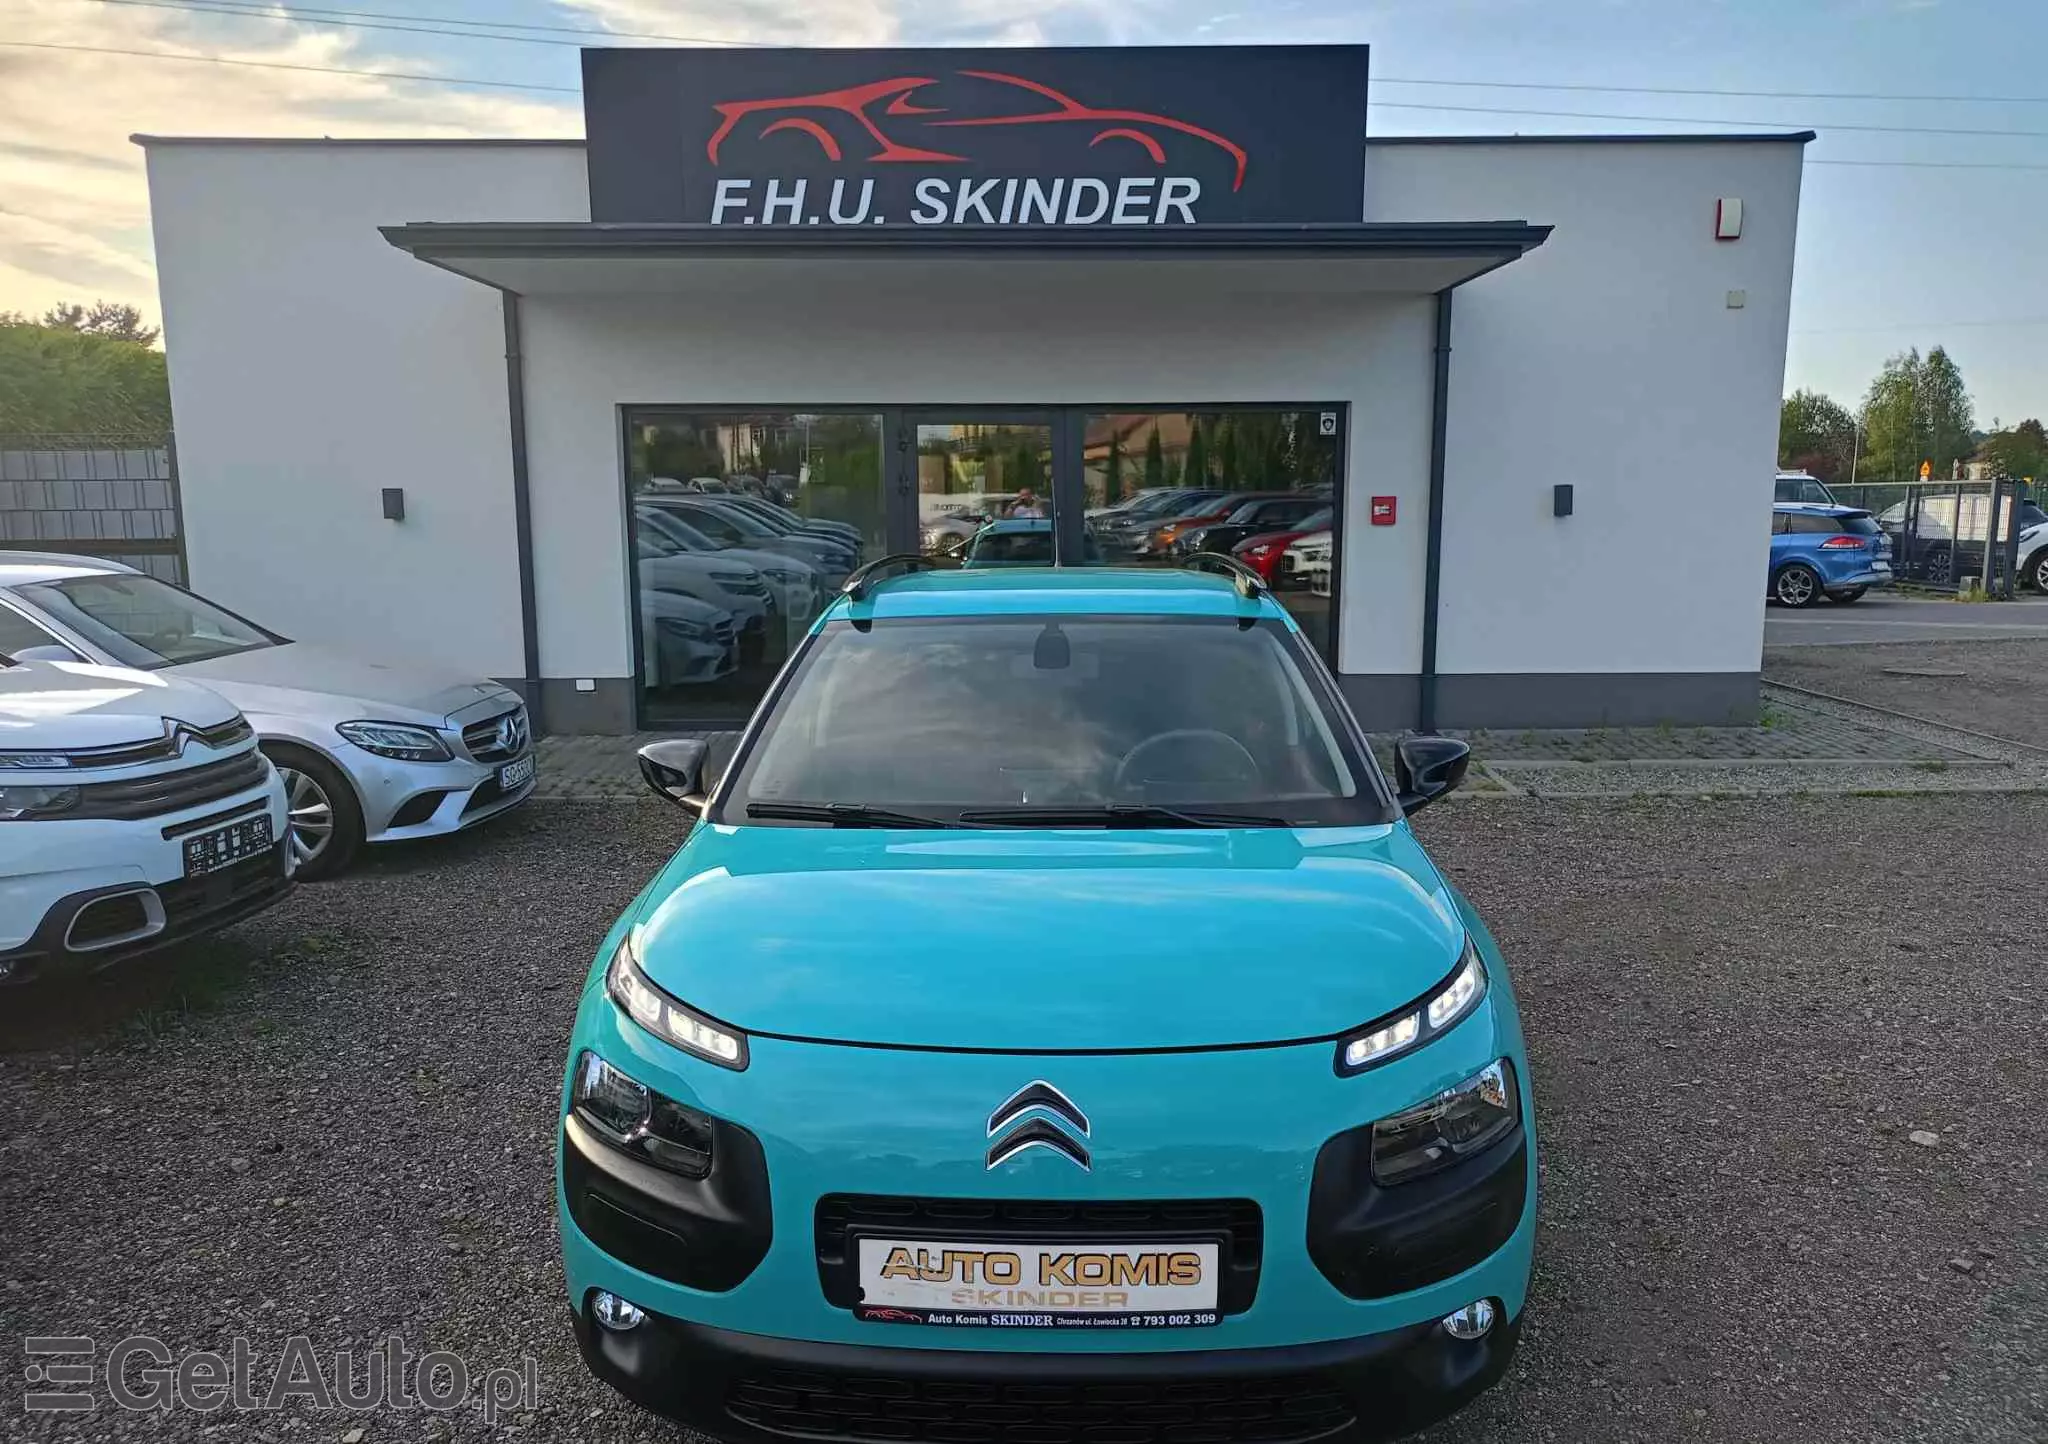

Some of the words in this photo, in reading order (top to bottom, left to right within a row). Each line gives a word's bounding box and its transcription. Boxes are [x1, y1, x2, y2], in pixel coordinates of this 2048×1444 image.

[710, 179, 885, 225] F.H.U.
[909, 177, 1201, 225] SKINDER
[880, 1247, 1022, 1286] AUTO
[1038, 1251, 1201, 1287] KOMIS
[951, 1287, 1129, 1308] SKINDER
[928, 1313, 953, 1324] Auto
[955, 1314, 988, 1325] Komis
[991, 1314, 1054, 1327] SKINDER
[1143, 1315, 1165, 1326] 793
[1168, 1314, 1191, 1325] 002
[1194, 1313, 1216, 1324] 309
